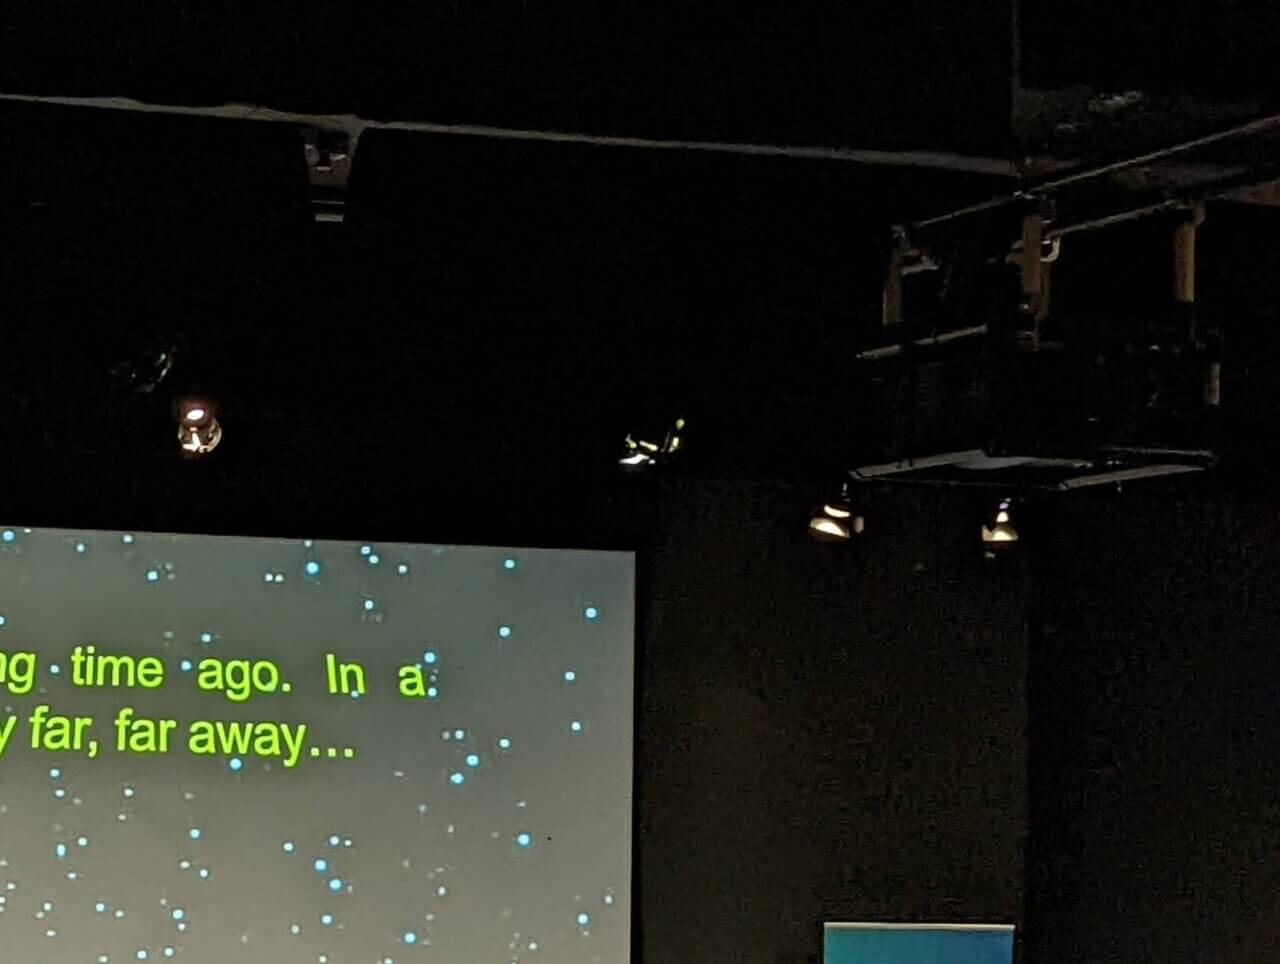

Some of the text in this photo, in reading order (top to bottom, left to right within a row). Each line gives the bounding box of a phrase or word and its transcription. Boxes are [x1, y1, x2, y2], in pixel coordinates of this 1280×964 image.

[70, 646, 165, 689] time
[196, 658, 292, 702] ago.
[326, 654, 366, 695] In
[398, 664, 426, 698] a
[28, 704, 100, 758] far,
[114, 706, 178, 754] far
[188, 720, 354, 768] away...
